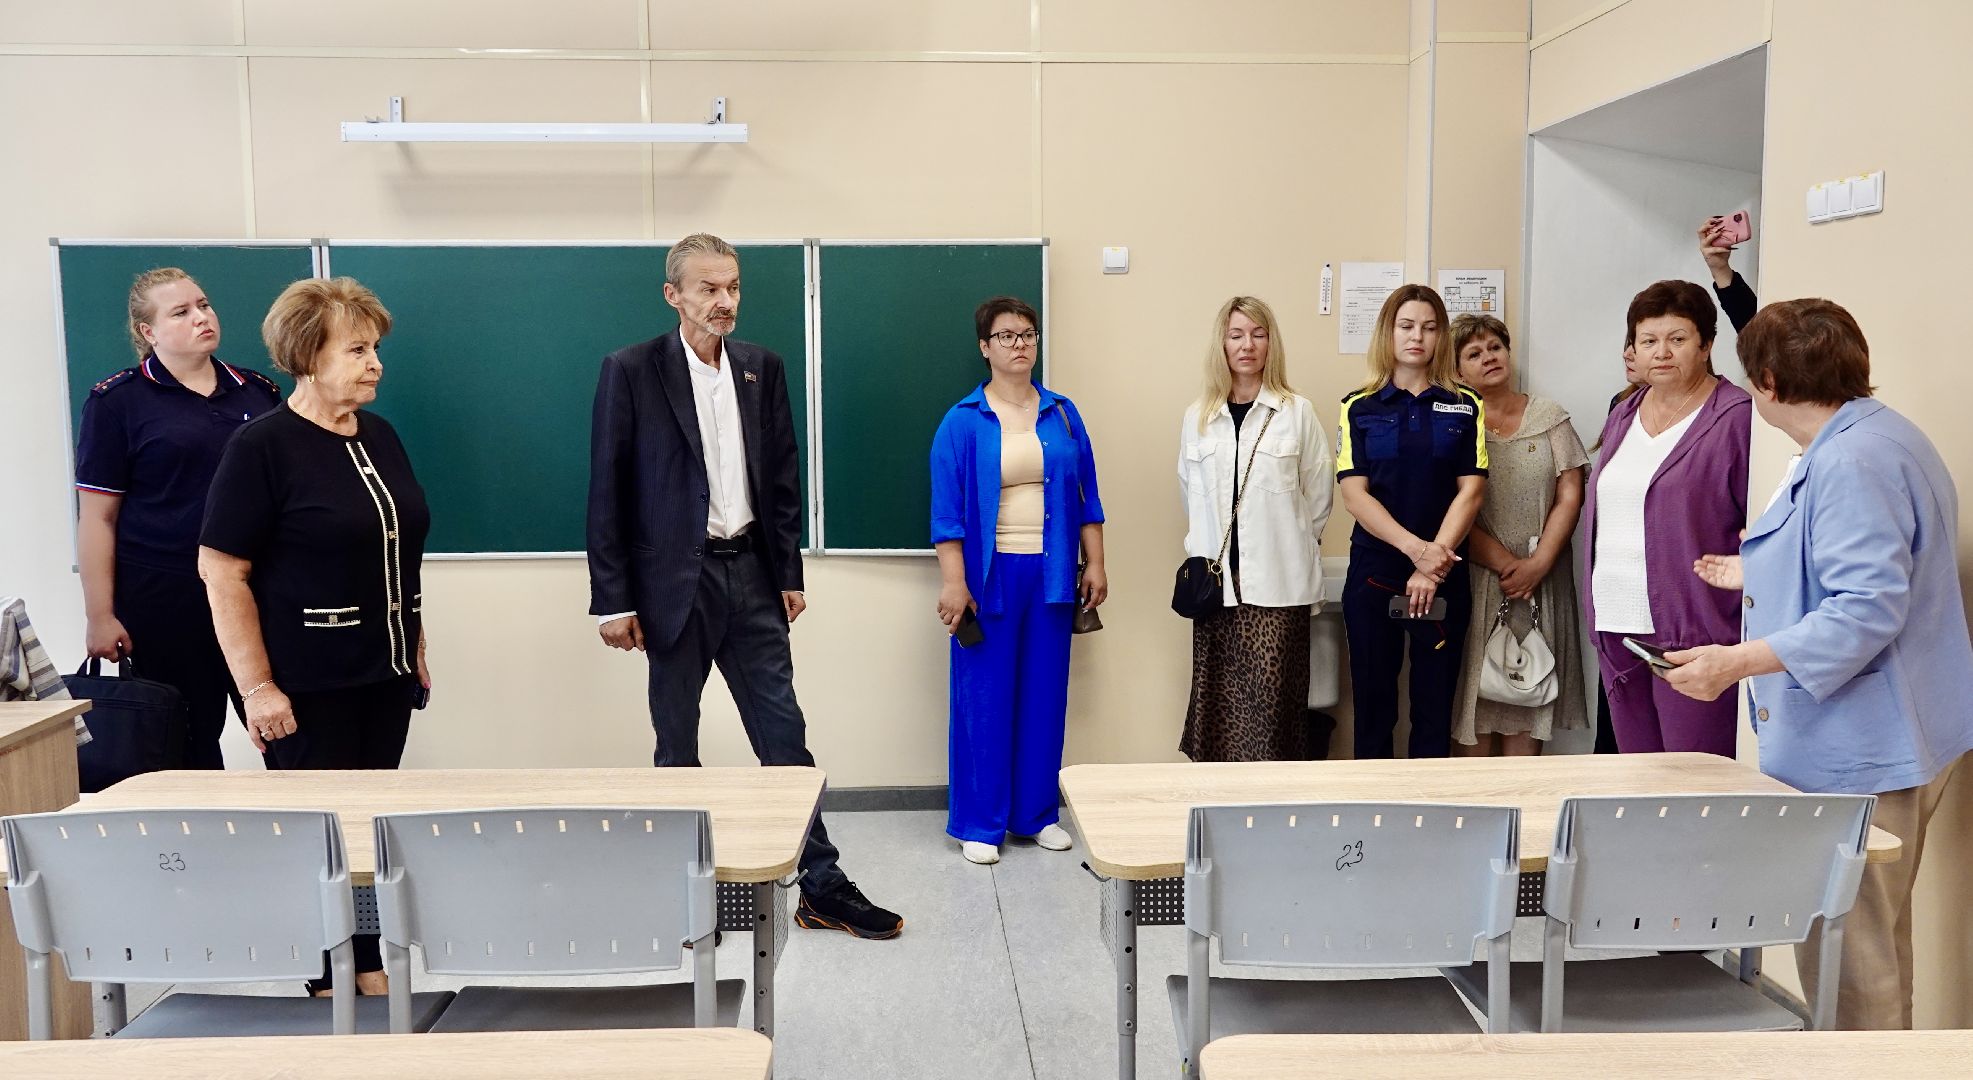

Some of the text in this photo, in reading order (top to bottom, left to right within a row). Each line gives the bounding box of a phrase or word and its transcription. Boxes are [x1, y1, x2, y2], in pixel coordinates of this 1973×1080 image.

[1434, 403, 1472, 413] ДПС ГИБДД
[159, 852, 186, 872] 23
[1336, 840, 1363, 871] 23
